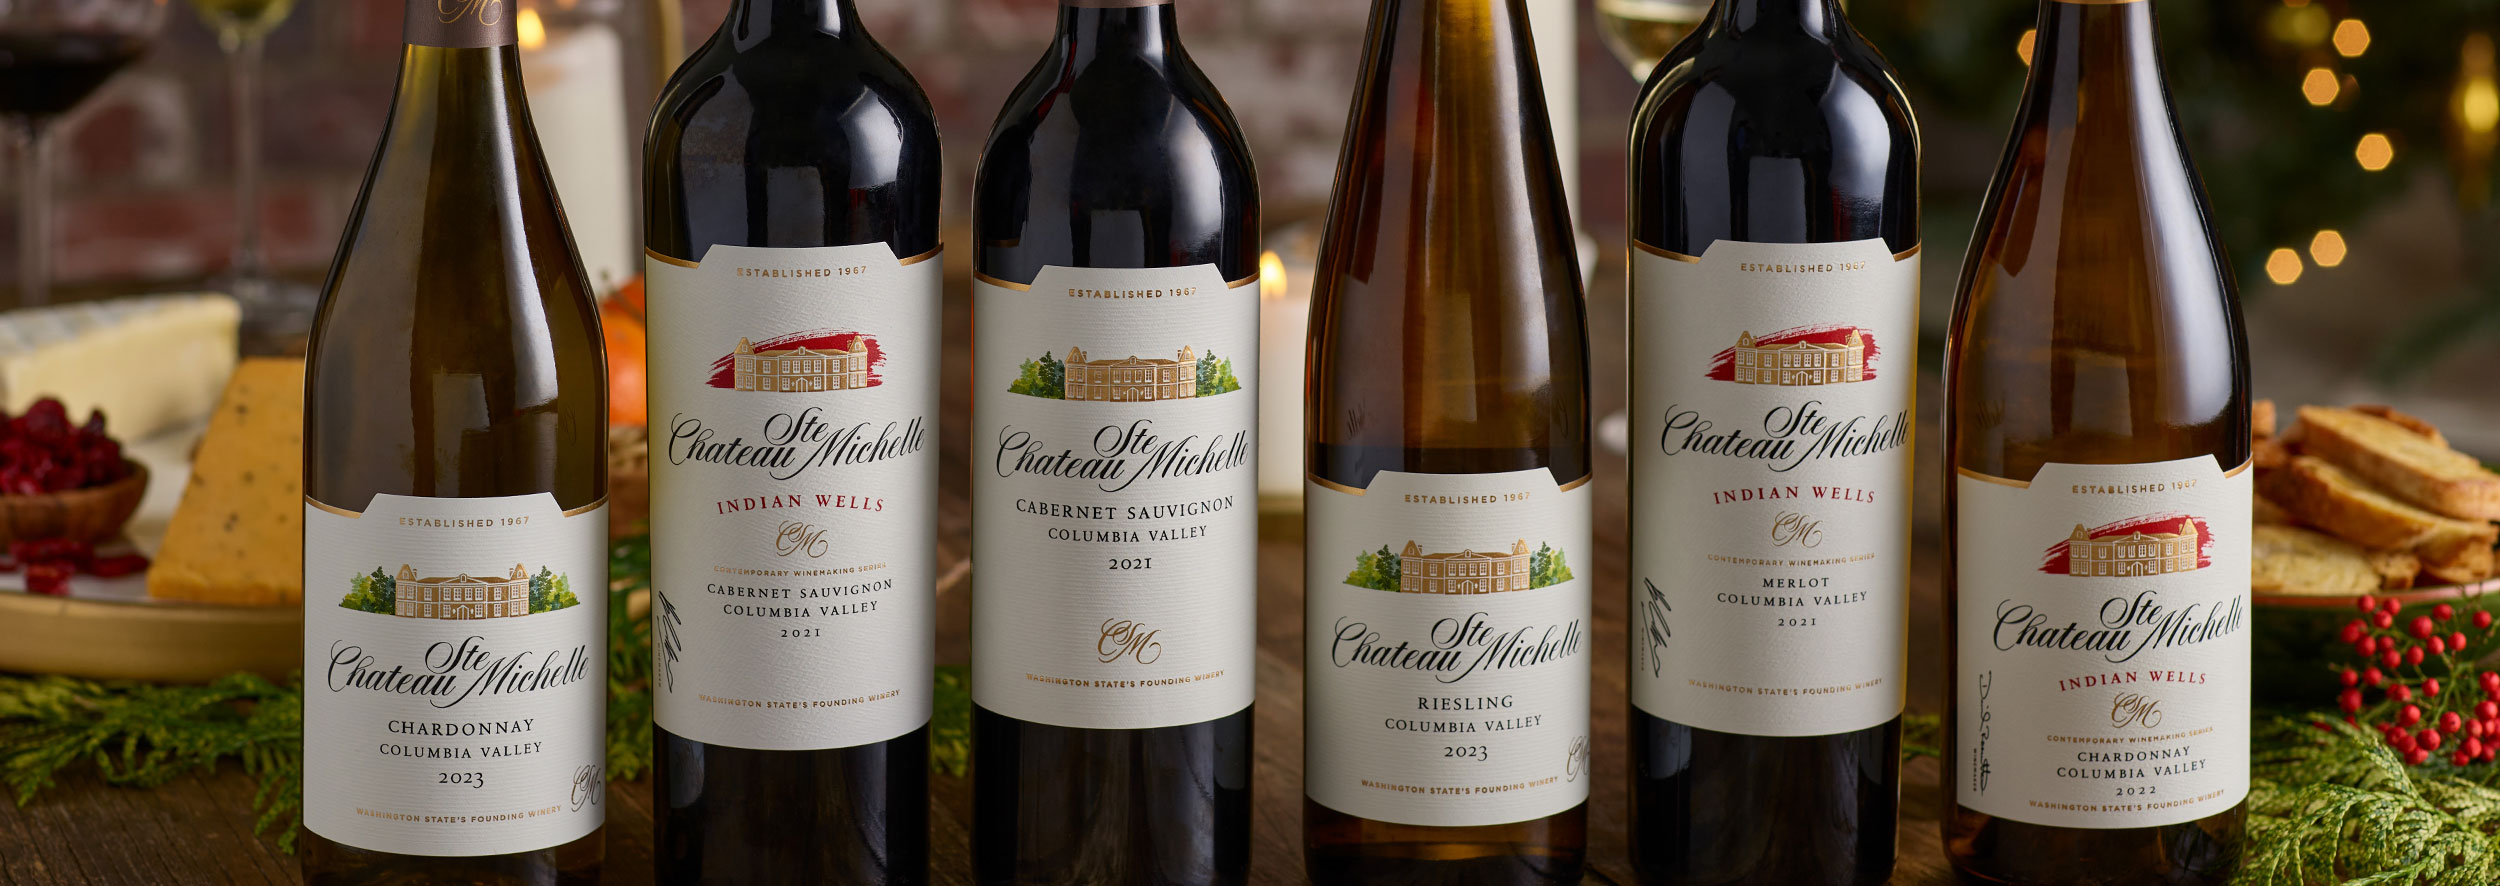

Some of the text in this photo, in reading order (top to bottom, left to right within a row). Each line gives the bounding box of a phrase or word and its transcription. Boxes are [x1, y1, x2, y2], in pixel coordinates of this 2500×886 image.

[737, 266, 867, 278] ESTABLISHED 1967
[1741, 261, 1865, 272] ESTABLISHED 1967
[1069, 287, 1197, 298] ESTABLISHED 1967
[669, 407, 924, 480] Chateau Ste Michelle
[1661, 400, 1909, 472] Chateau Ste Michelle
[996, 419, 1248, 492] Chateau Ste Michelle
[1713, 486, 1874, 504] INDIAN WELLS
[2072, 479, 2197, 494] ESTABLISHED 1967
[717, 495, 883, 514] INDIAN WELLS
[1404, 492, 1530, 504] ESTABLISHED 1967
[1016, 496, 1233, 519] CABERNET SAUVIGNON
[400, 516, 529, 527] ESTABLISHED 1967
[1049, 525, 1207, 542] COLUMBIA VALLEY
[1109, 558, 1152, 569] 2021
[1707, 554, 1783, 567] CONTEMPORARY
[1788, 557, 1846, 567] WINEMAKING
[714, 565, 788, 576] CONTEMPORARY
[794, 567, 854, 576] WINEMAKING
[708, 579, 892, 599] CABERNET SAUVIGNON
[1762, 578, 1829, 588] MERLOT
[1717, 591, 1867, 606] COLUMBIA VALLEY
[724, 601, 878, 617] COLUMBIA VALLEY
[1431, 612, 1493, 648] Ste
[1778, 619, 1816, 627] 2021
[1993, 590, 2243, 663] Chateau Ste Michelle
[781, 629, 820, 637] 2021
[1332, 616, 1461, 671] Chateau
[1435, 618, 1582, 683] Michelle
[425, 636, 489, 674] Ste
[328, 639, 456, 696] Chateau
[430, 645, 589, 708] Michelle
[1026, 670, 1224, 688] WASHINGTON STATE'S FOUNDING WINERY
[2059, 671, 2206, 692] INDIAN WELLS
[1688, 679, 1753, 694] WASHINGTON
[1803, 685, 1851, 695] FOUNDING
[1855, 678, 1883, 689] WINERY
[699, 694, 761, 707] WASHINGTON
[813, 697, 865, 707] FOUNDING
[869, 689, 900, 702] WINERY
[1418, 695, 1513, 710] RIESLING
[388, 719, 535, 736] CHARDONNAY
[1385, 714, 1542, 733] COLUMBIA VALLEY
[2047, 735, 2124, 744] CONTEMPORARY
[2129, 732, 2185, 743] WINEMAKING
[380, 742, 542, 758] COLUMBIA VALLEY
[1444, 746, 1487, 761] 2023
[2078, 746, 2190, 762] CHARDONNAY
[2057, 759, 2206, 779] COLUMBIA VALLEY
[439, 772, 483, 788] 2023
[1361, 776, 1558, 794] WASHINGTON STATE'S FOUNDING WINERY
[2116, 786, 2156, 796] 2022
[2029, 800, 2097, 812] WASHINGTON
[2147, 798, 2194, 809] FOUNDING
[2198, 789, 2224, 802] WINERY
[356, 805, 562, 823] WASHINGTON STATE'S FOUNDING WINERY
